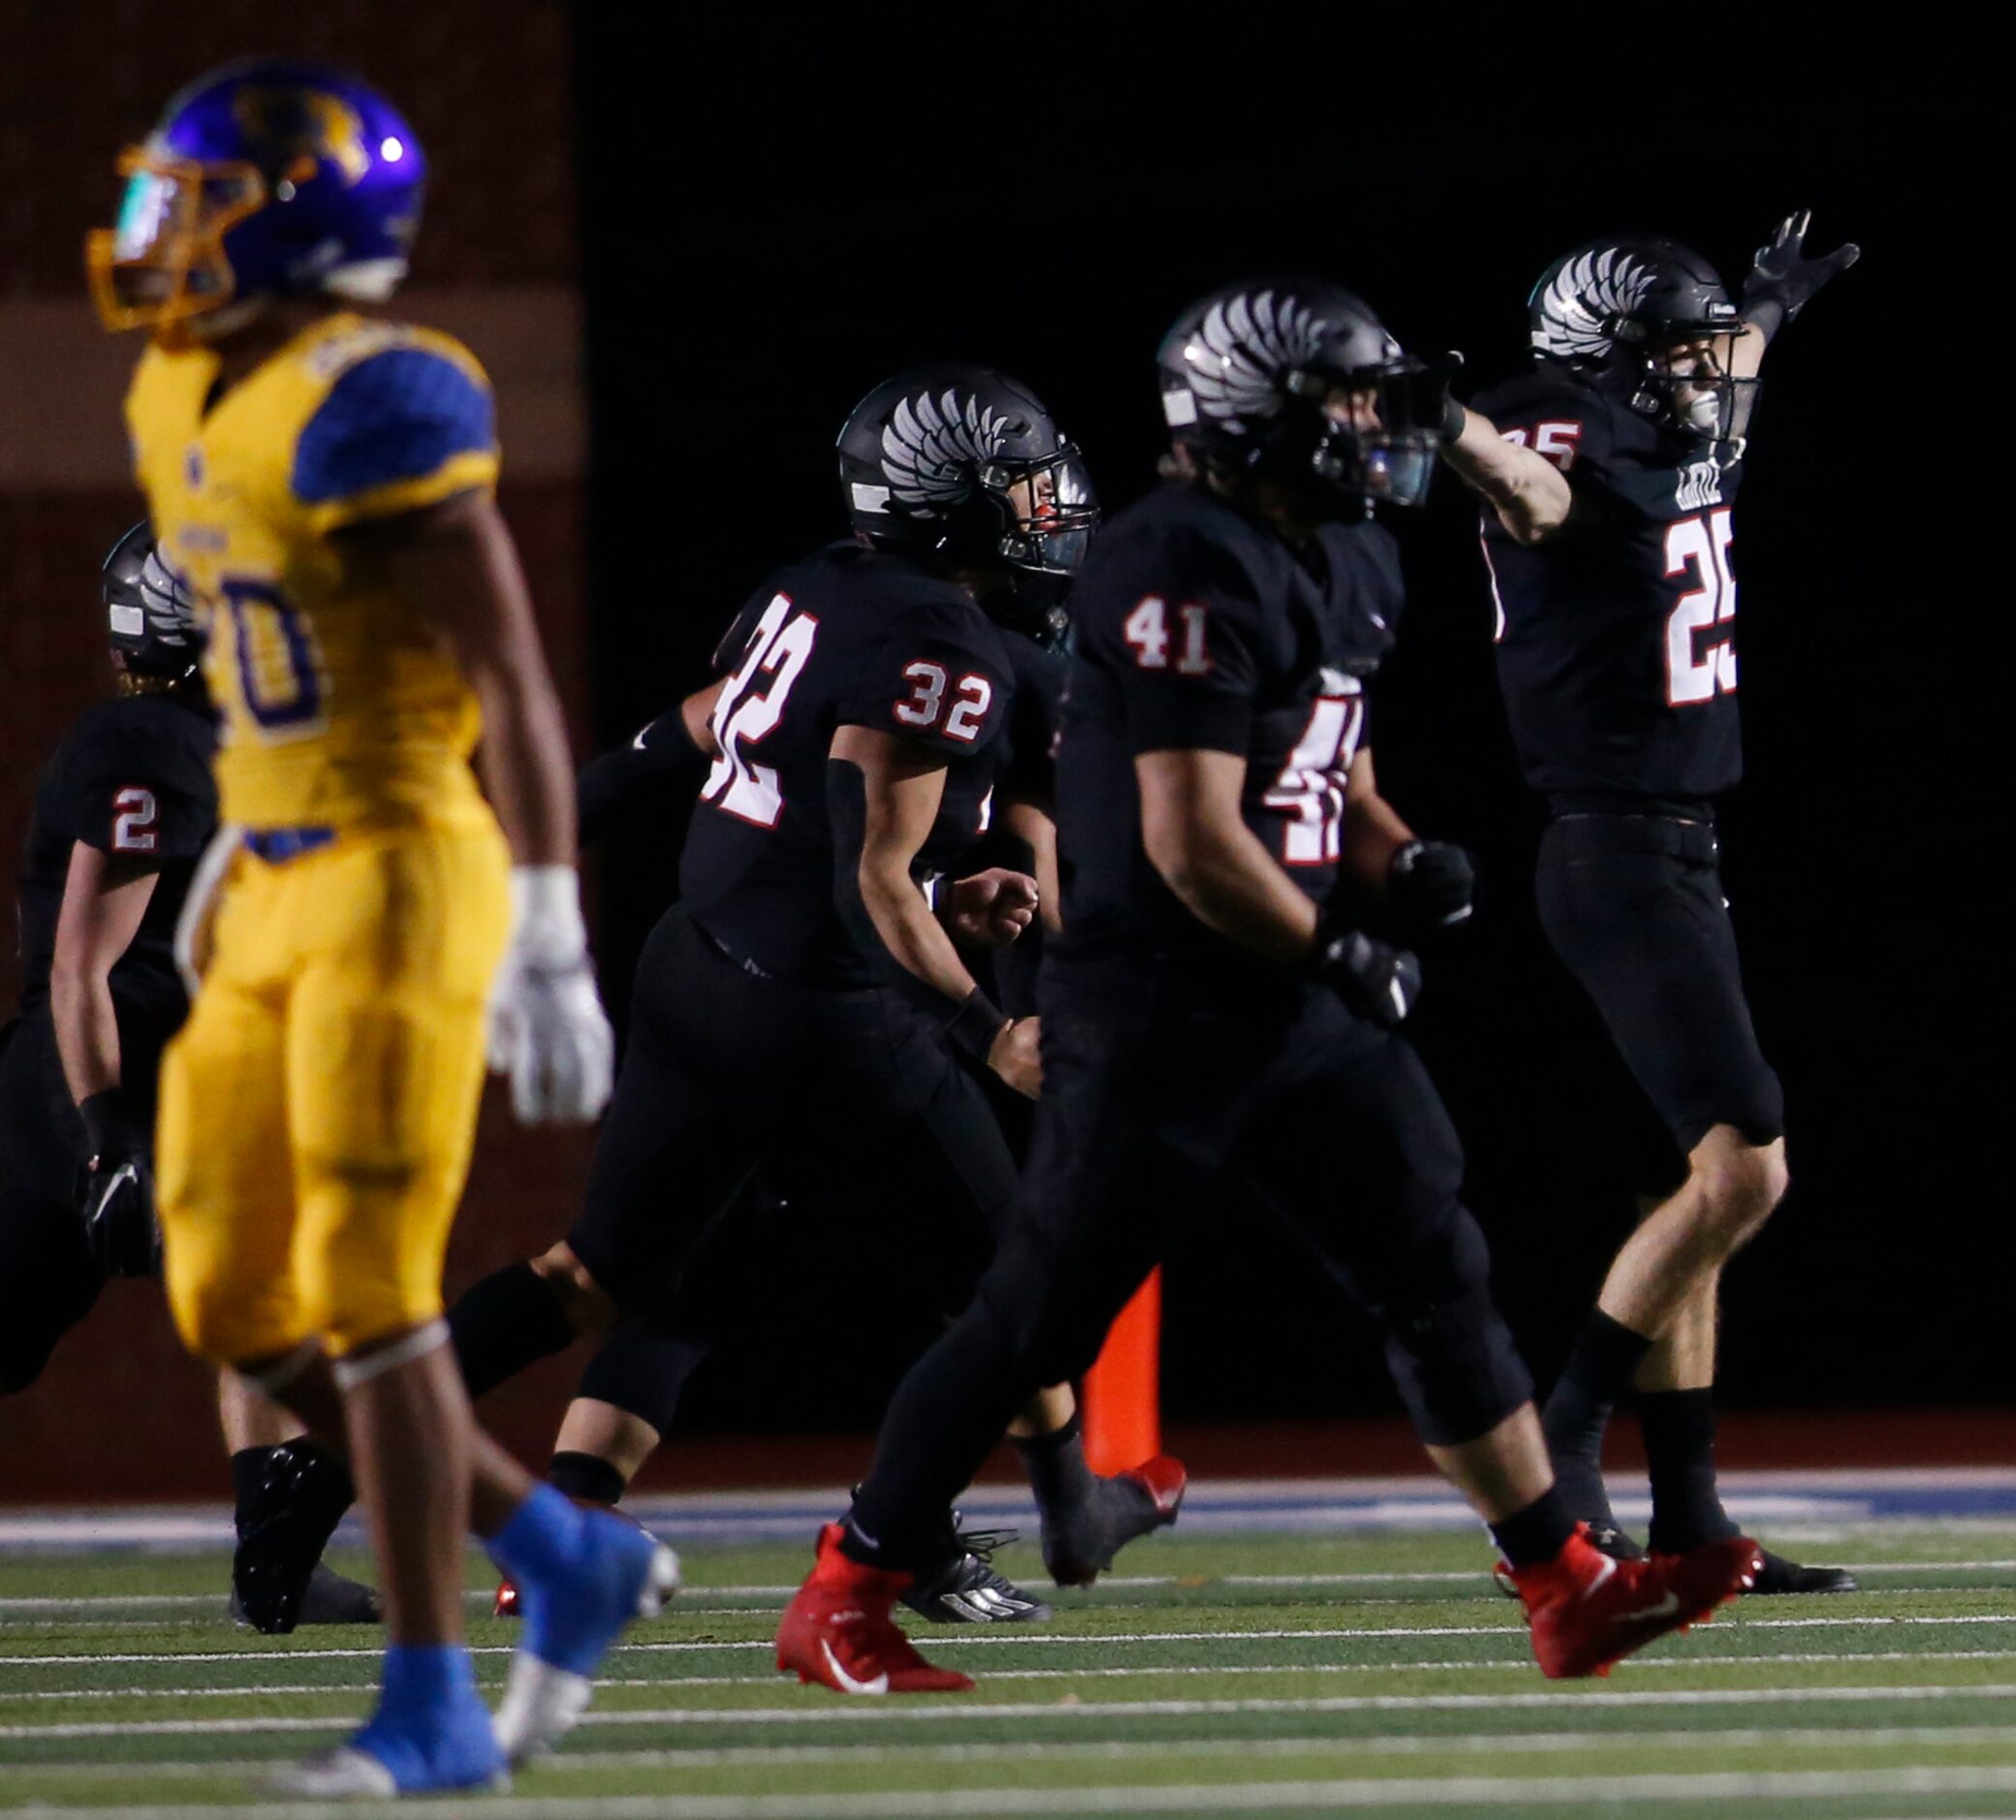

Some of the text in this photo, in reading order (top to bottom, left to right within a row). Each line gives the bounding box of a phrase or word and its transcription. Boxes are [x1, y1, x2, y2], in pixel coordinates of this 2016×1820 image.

[1124, 592, 1213, 675] 41
[892, 658, 992, 743] 32
[111, 784, 158, 853] 2
